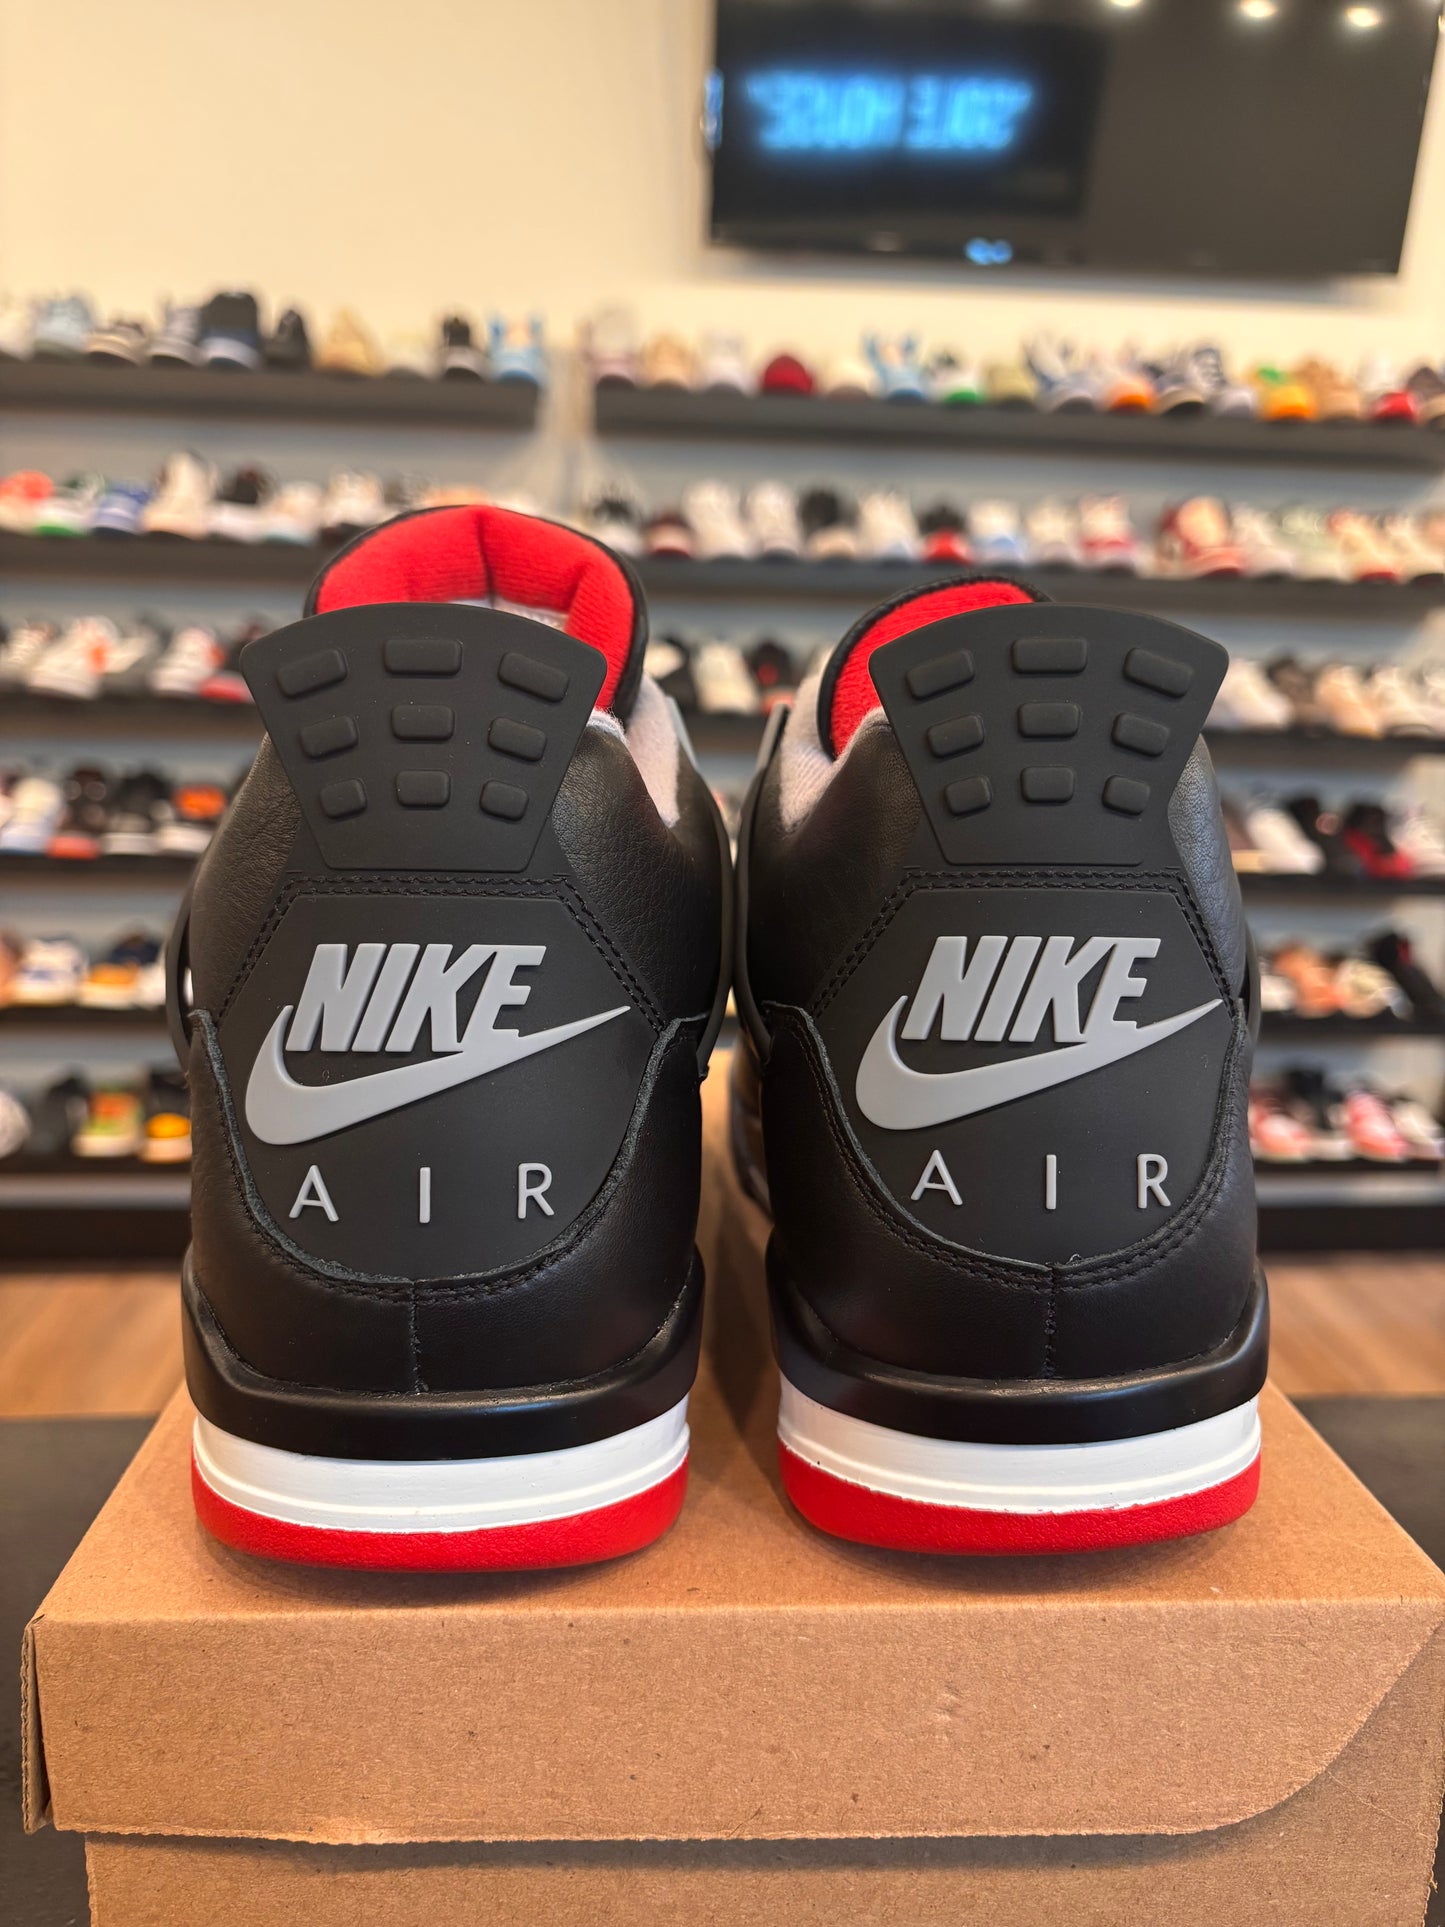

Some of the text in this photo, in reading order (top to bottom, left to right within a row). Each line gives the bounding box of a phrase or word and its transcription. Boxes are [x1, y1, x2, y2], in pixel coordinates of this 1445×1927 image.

[285, 943, 547, 1052] NIKE
[900, 935, 1162, 1042] NIKE
[288, 1162, 555, 1224] AIR
[910, 1149, 1172, 1210] AIR
